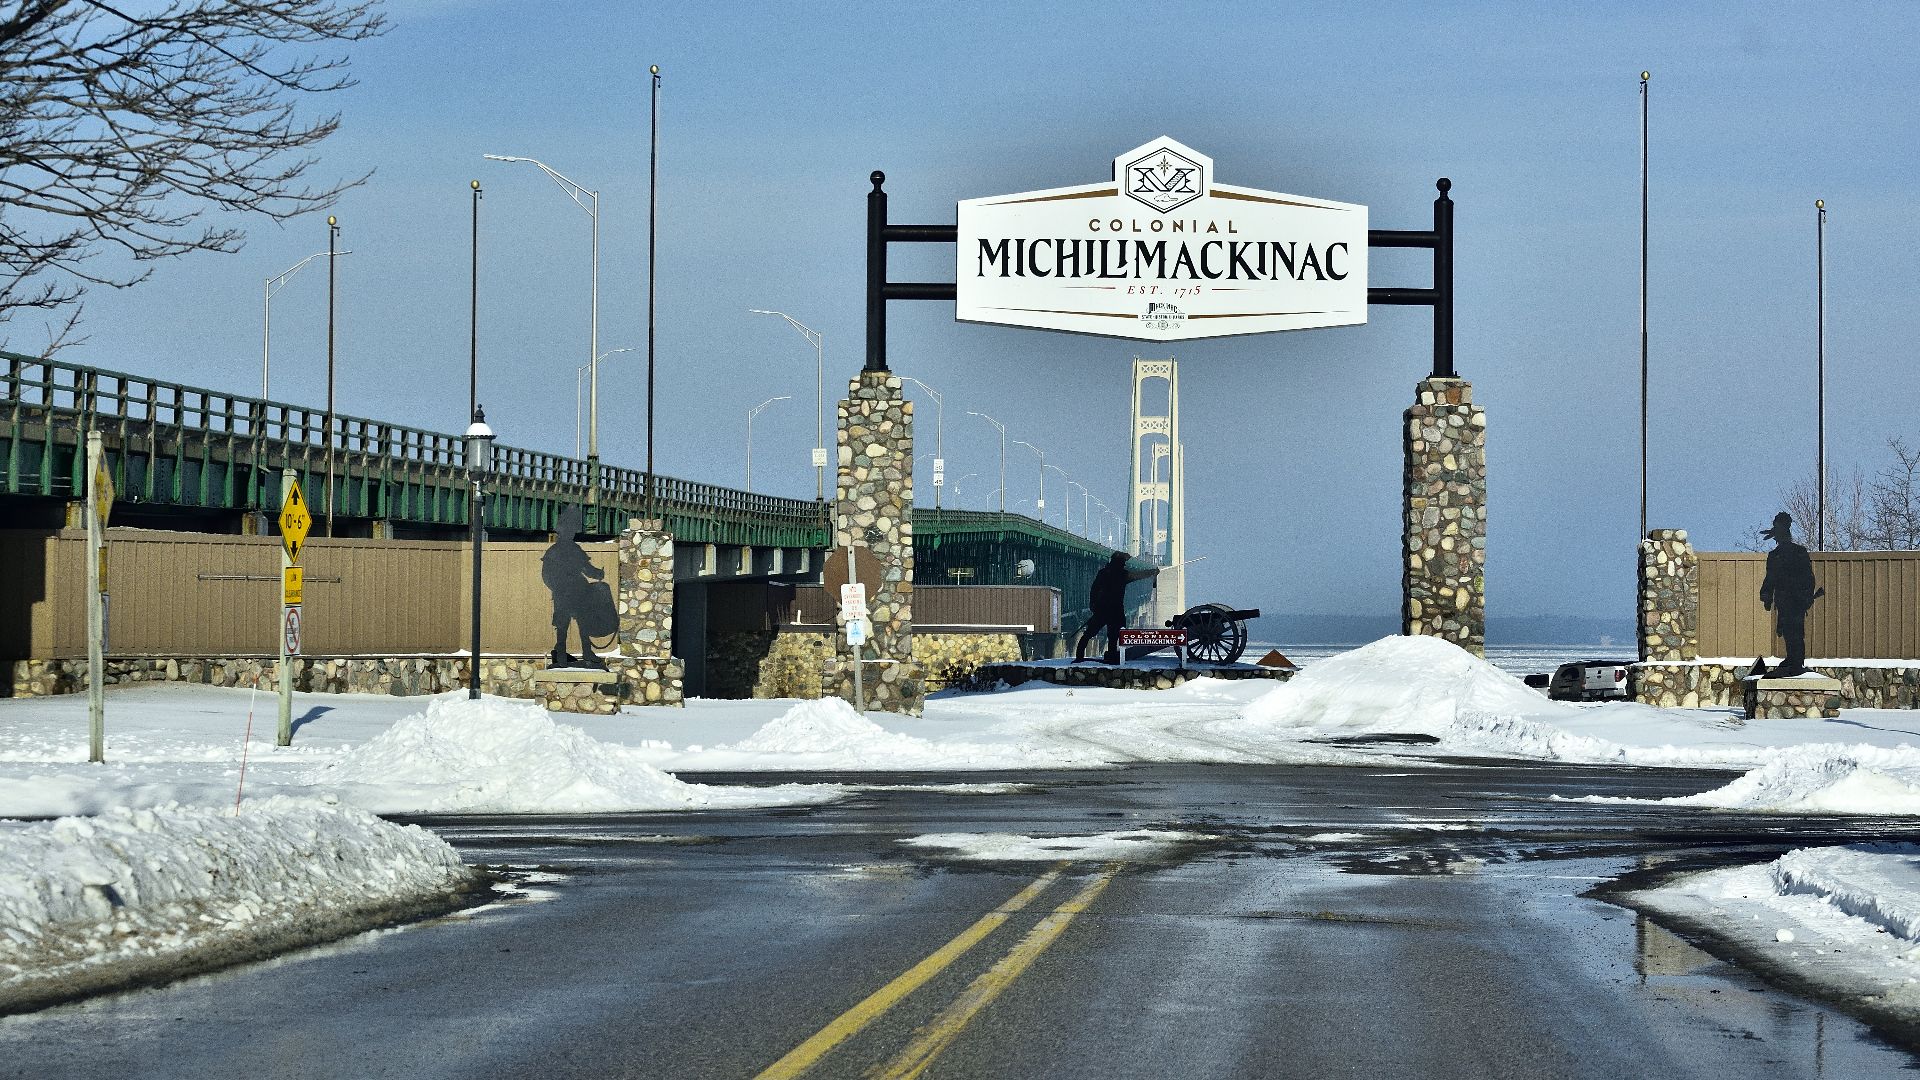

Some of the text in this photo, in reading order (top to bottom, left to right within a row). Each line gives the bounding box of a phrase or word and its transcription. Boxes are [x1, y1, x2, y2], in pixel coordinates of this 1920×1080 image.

[1088, 218, 1238, 234] COLONIAL
[976, 238, 1349, 281] MICHILIMACKINAC
[1127, 285, 1202, 299] EST. 1715
